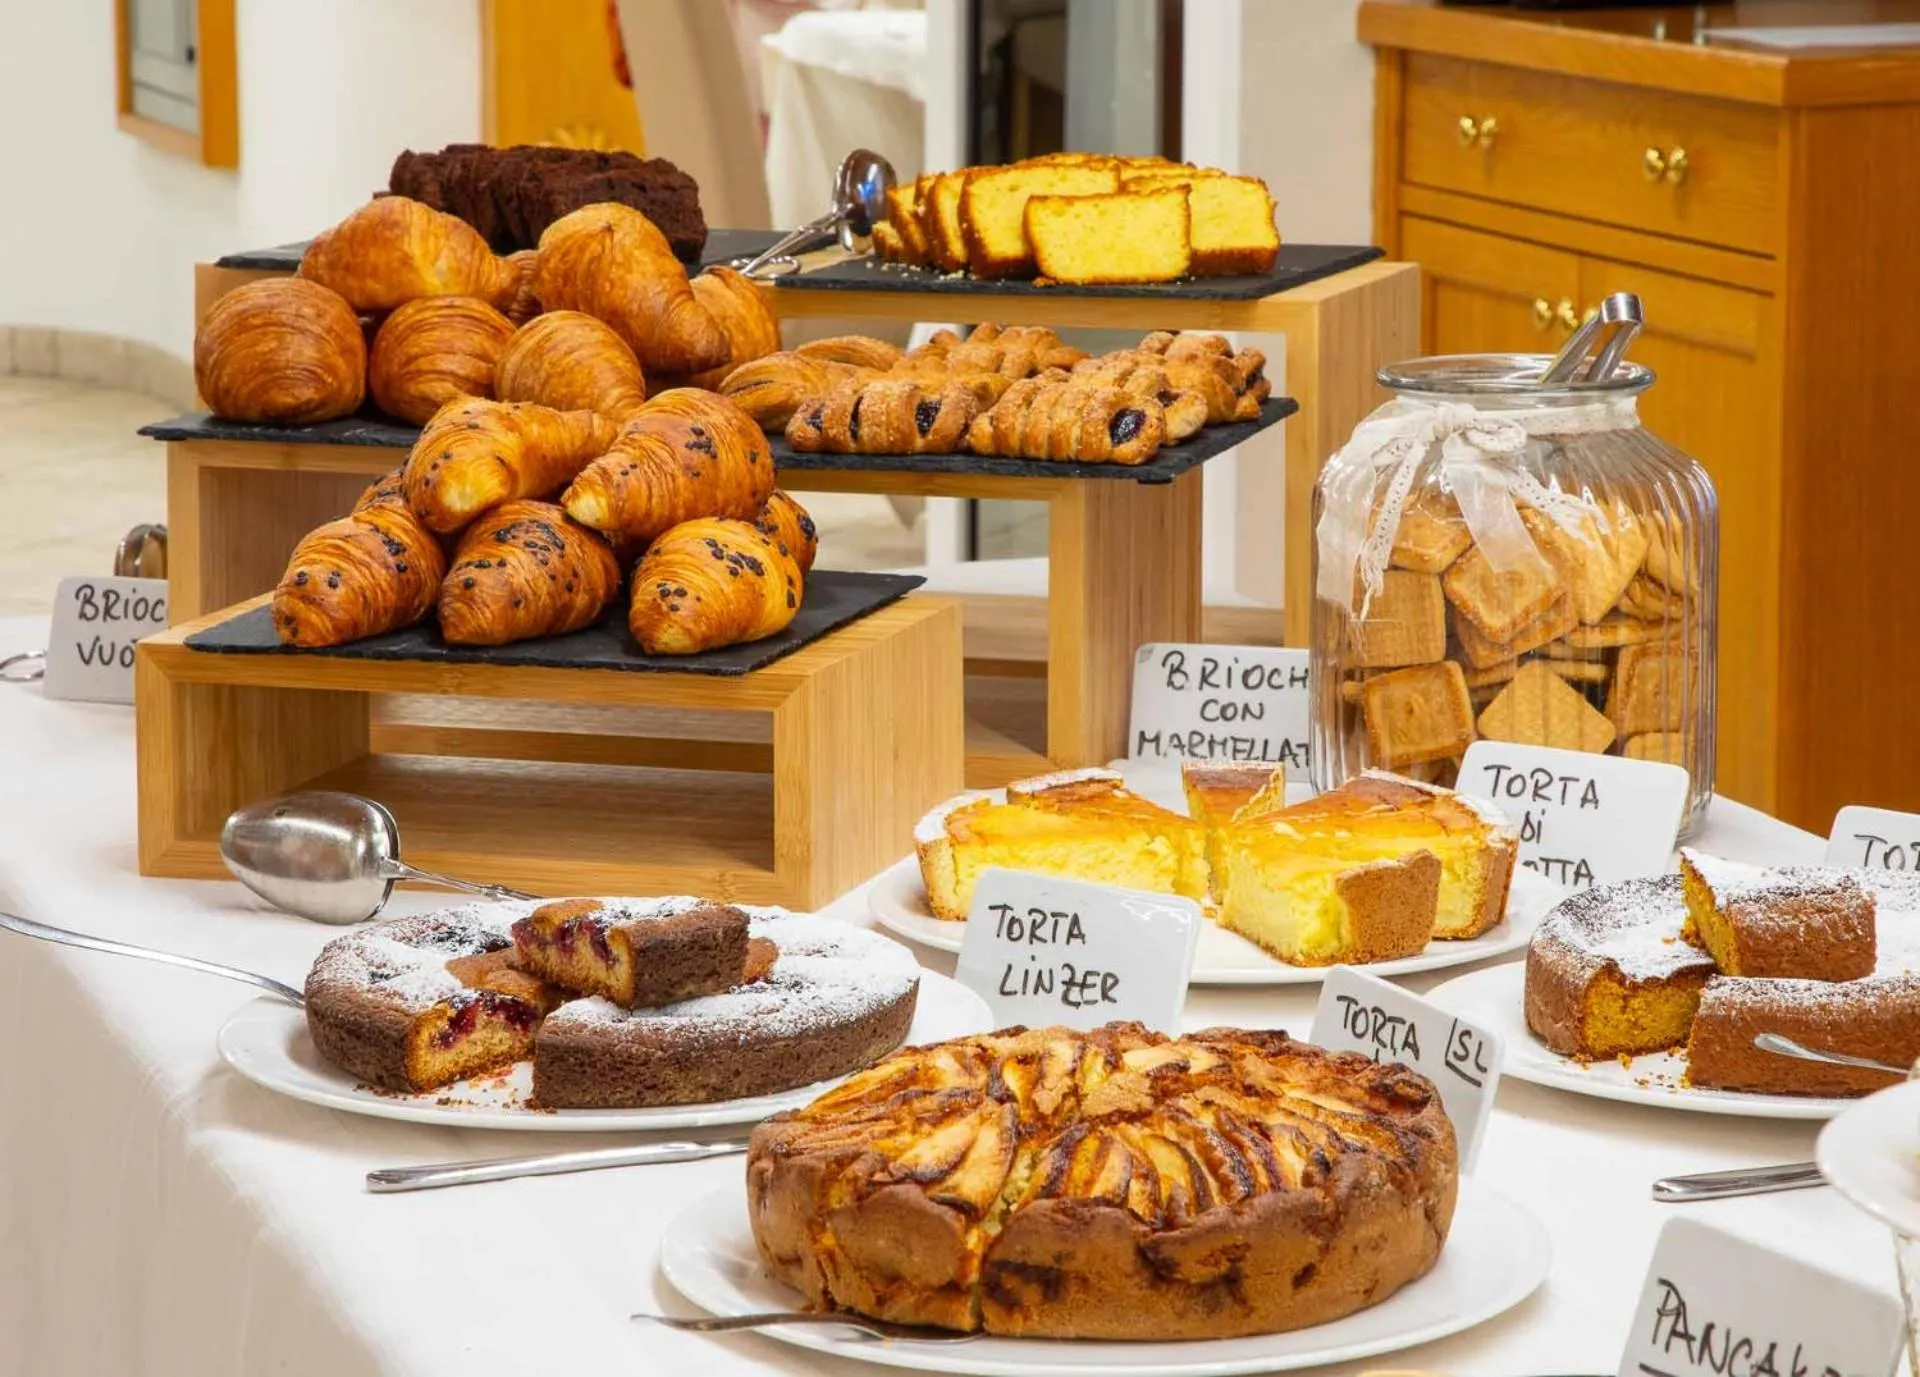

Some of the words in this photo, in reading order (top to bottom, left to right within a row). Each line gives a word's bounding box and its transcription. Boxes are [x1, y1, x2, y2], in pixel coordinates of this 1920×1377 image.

[77, 635, 138, 668] VUO
[1200, 699, 1264, 722] CON
[1483, 764, 1599, 809] TORTA
[988, 903, 1086, 945] TORTA
[1336, 995, 1420, 1061] TORTA
[1453, 1029, 1488, 1074] SL
[1652, 1278, 1841, 1377] PANCAK
